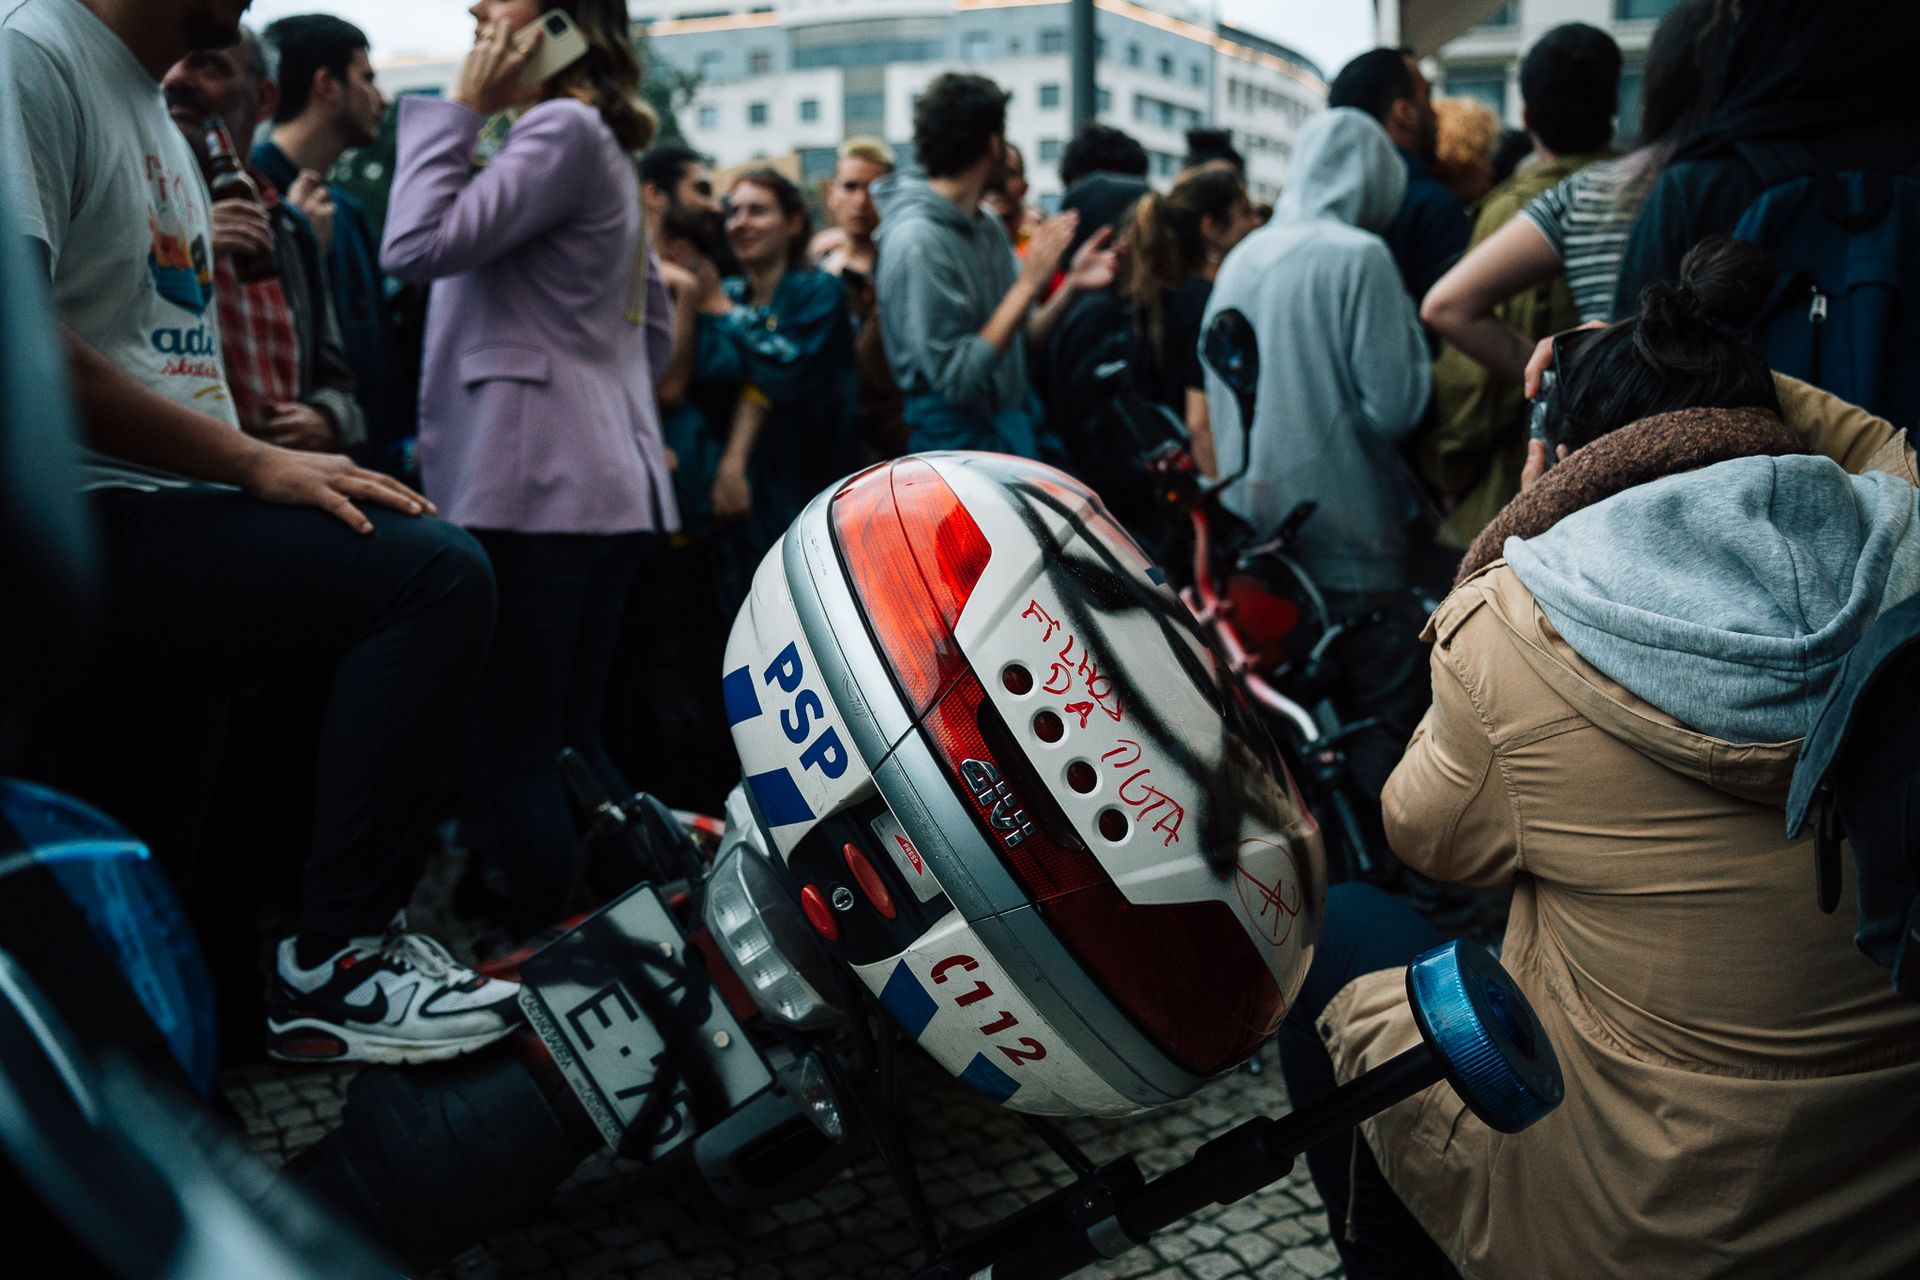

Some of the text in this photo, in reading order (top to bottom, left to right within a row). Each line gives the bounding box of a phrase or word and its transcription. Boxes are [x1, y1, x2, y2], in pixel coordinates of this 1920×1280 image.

[764, 642, 847, 778] PSP
[1042, 662, 1184, 846] DA PUTA
[902, 843, 919, 864] PRESS
[959, 756, 1036, 848] GIVI
[930, 954, 1048, 1067] C112
